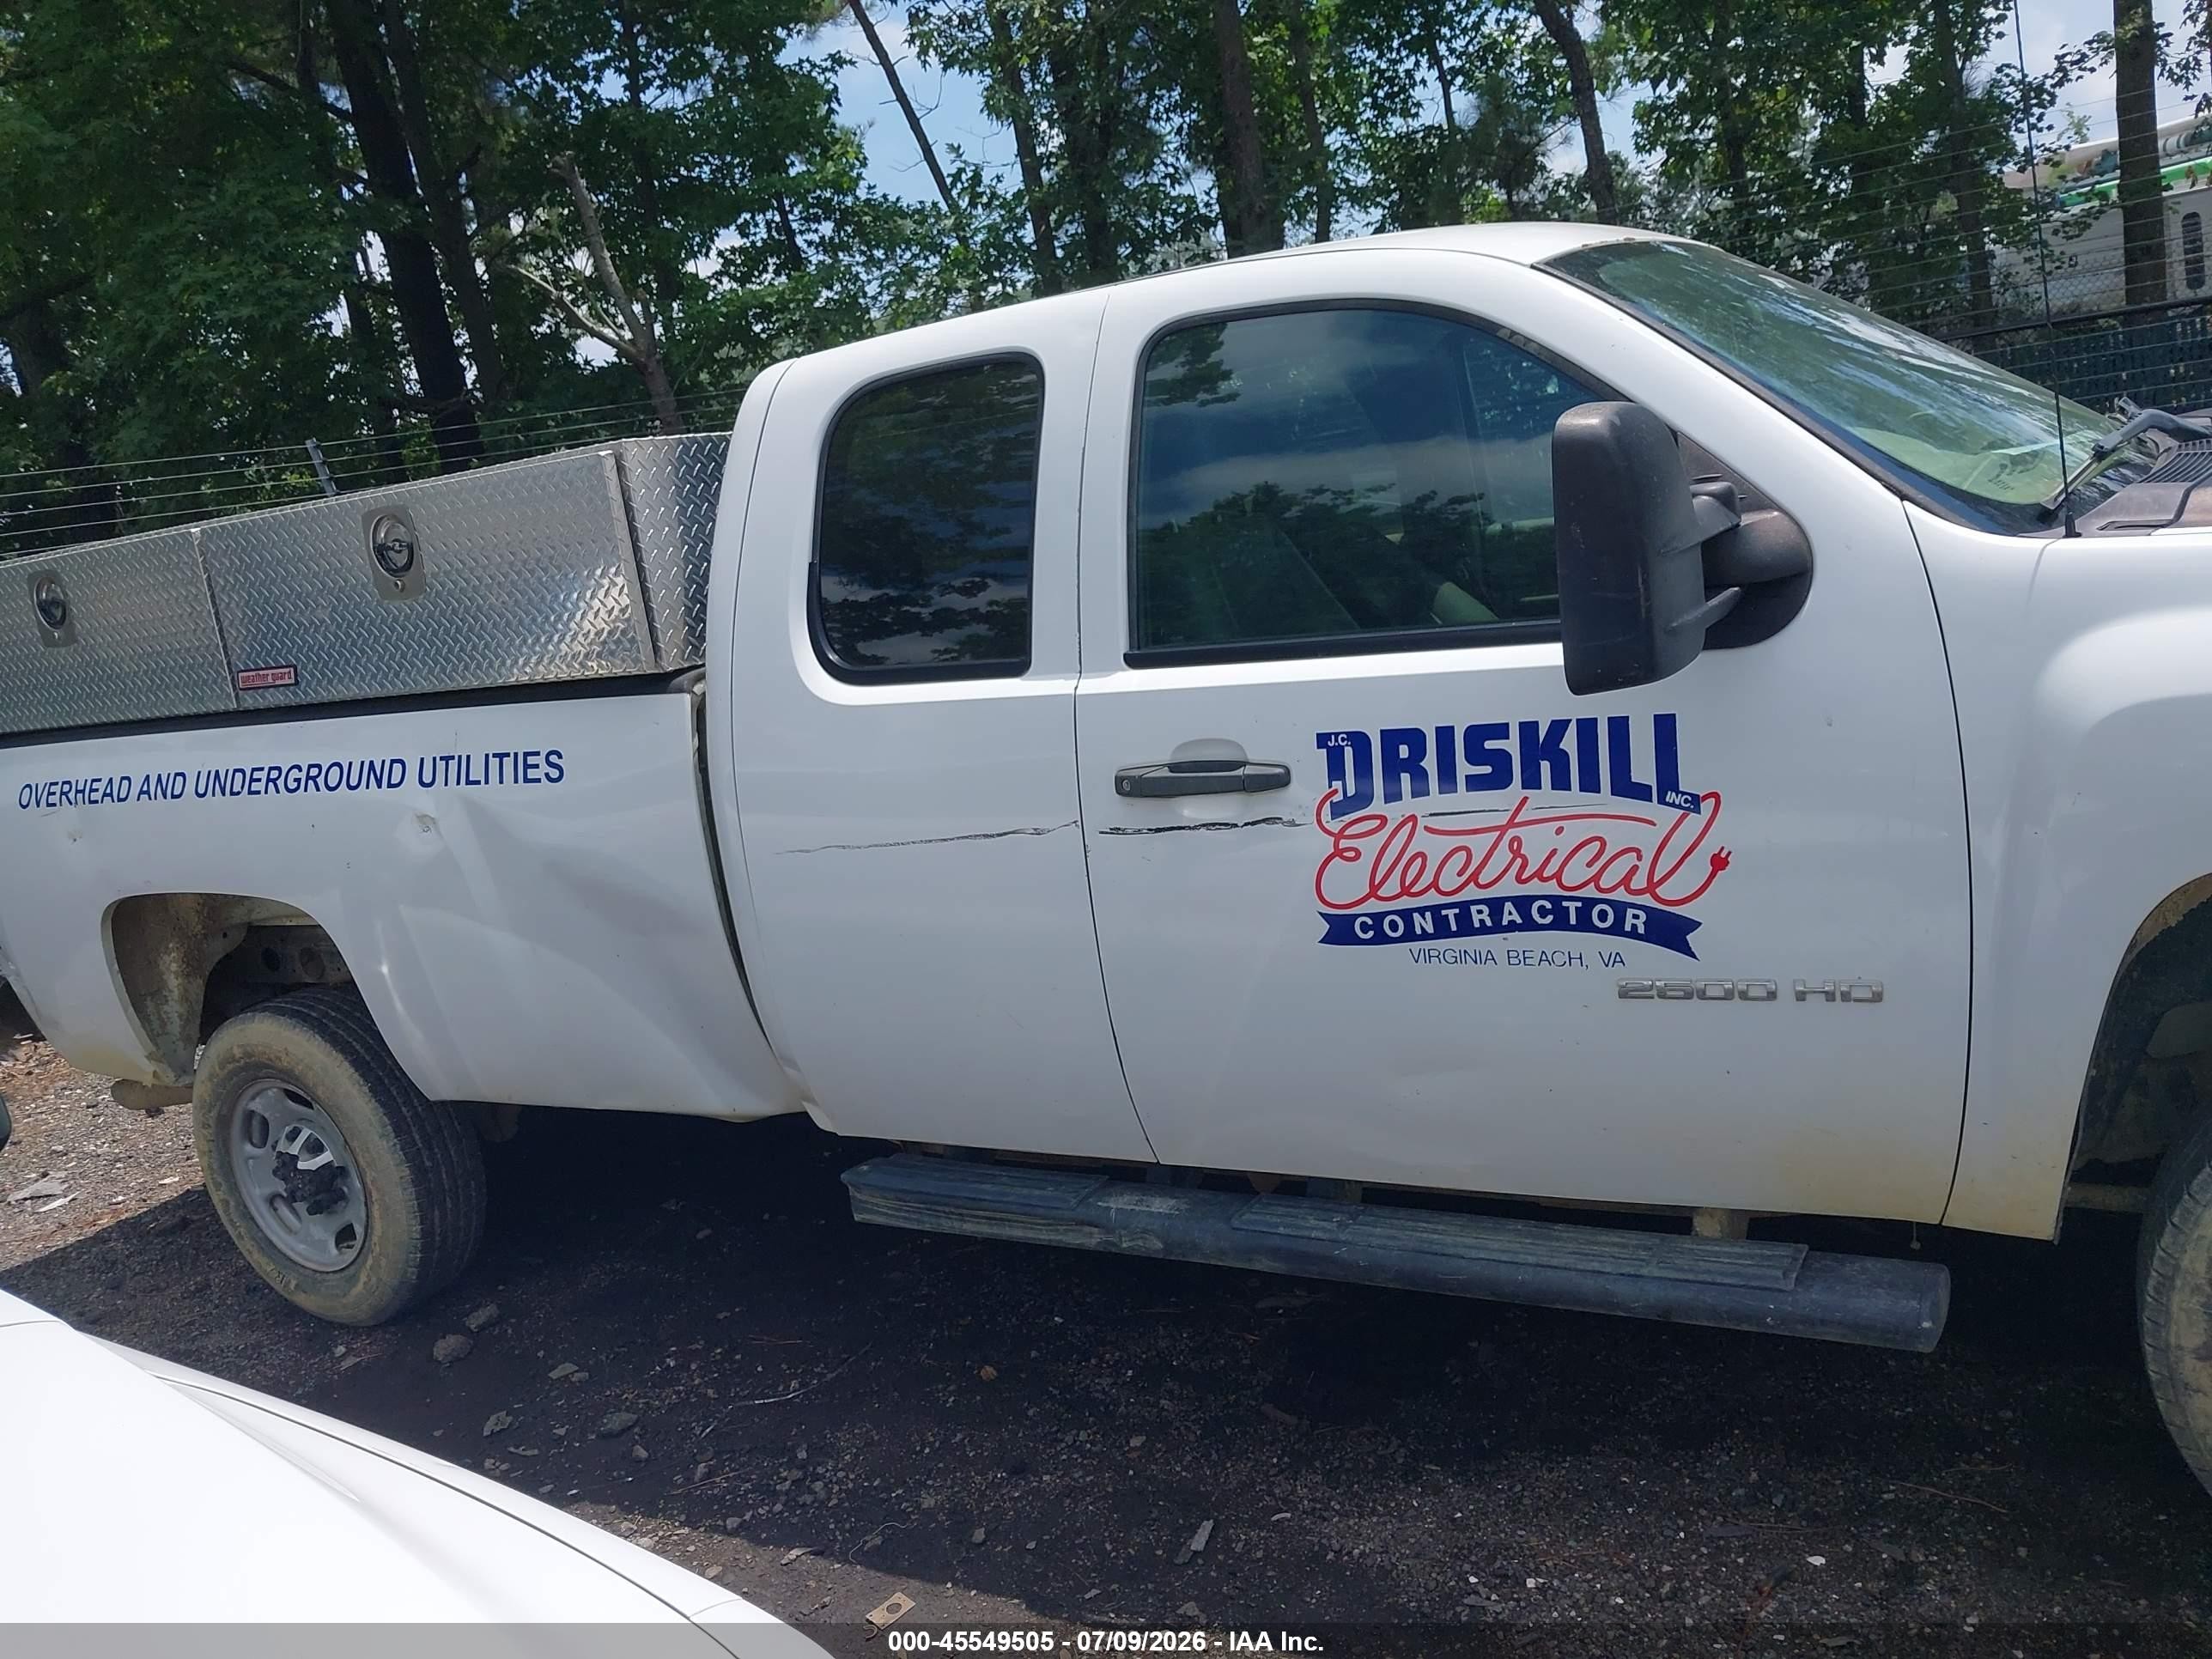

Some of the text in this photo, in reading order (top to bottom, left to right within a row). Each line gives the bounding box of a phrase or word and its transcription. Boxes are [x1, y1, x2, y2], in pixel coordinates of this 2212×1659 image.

[241, 670, 292, 684] weather guard
[18, 750, 564, 810] OVERHEAD AND UNDERGROUND UTILITIES
[1316, 714, 1702, 820] J.C. DRISKILL INC.
[1316, 788, 1722, 910] Electrical
[1353, 900, 1648, 940] CONTRACTOR
[1409, 948, 1626, 969] VIRGINIA BEACH, VA
[1618, 978, 1884, 1003] 2500 HD
